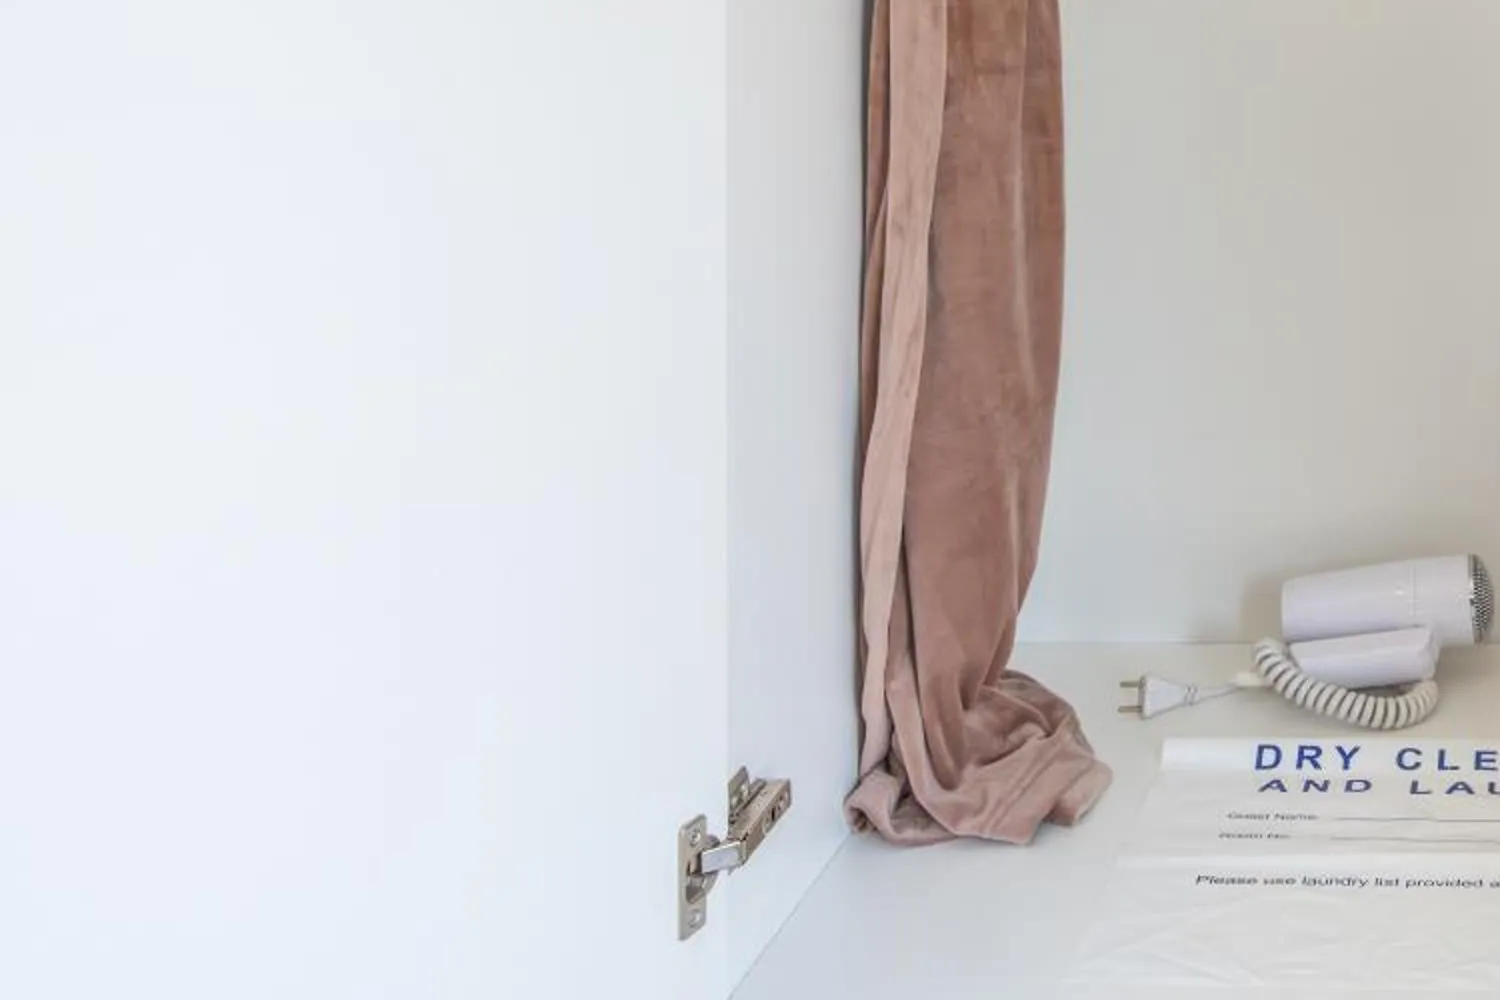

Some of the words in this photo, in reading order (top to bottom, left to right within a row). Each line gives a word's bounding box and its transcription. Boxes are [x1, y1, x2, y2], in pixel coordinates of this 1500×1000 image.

[1254, 743, 1361, 771] DRY
[1257, 778, 1373, 793] AND
[1195, 873, 1258, 886] Please
[1263, 877, 1297, 886] use
[1302, 874, 1369, 888] laundry
[1374, 876, 1399, 888] list
[1405, 877, 1484, 890] provided
